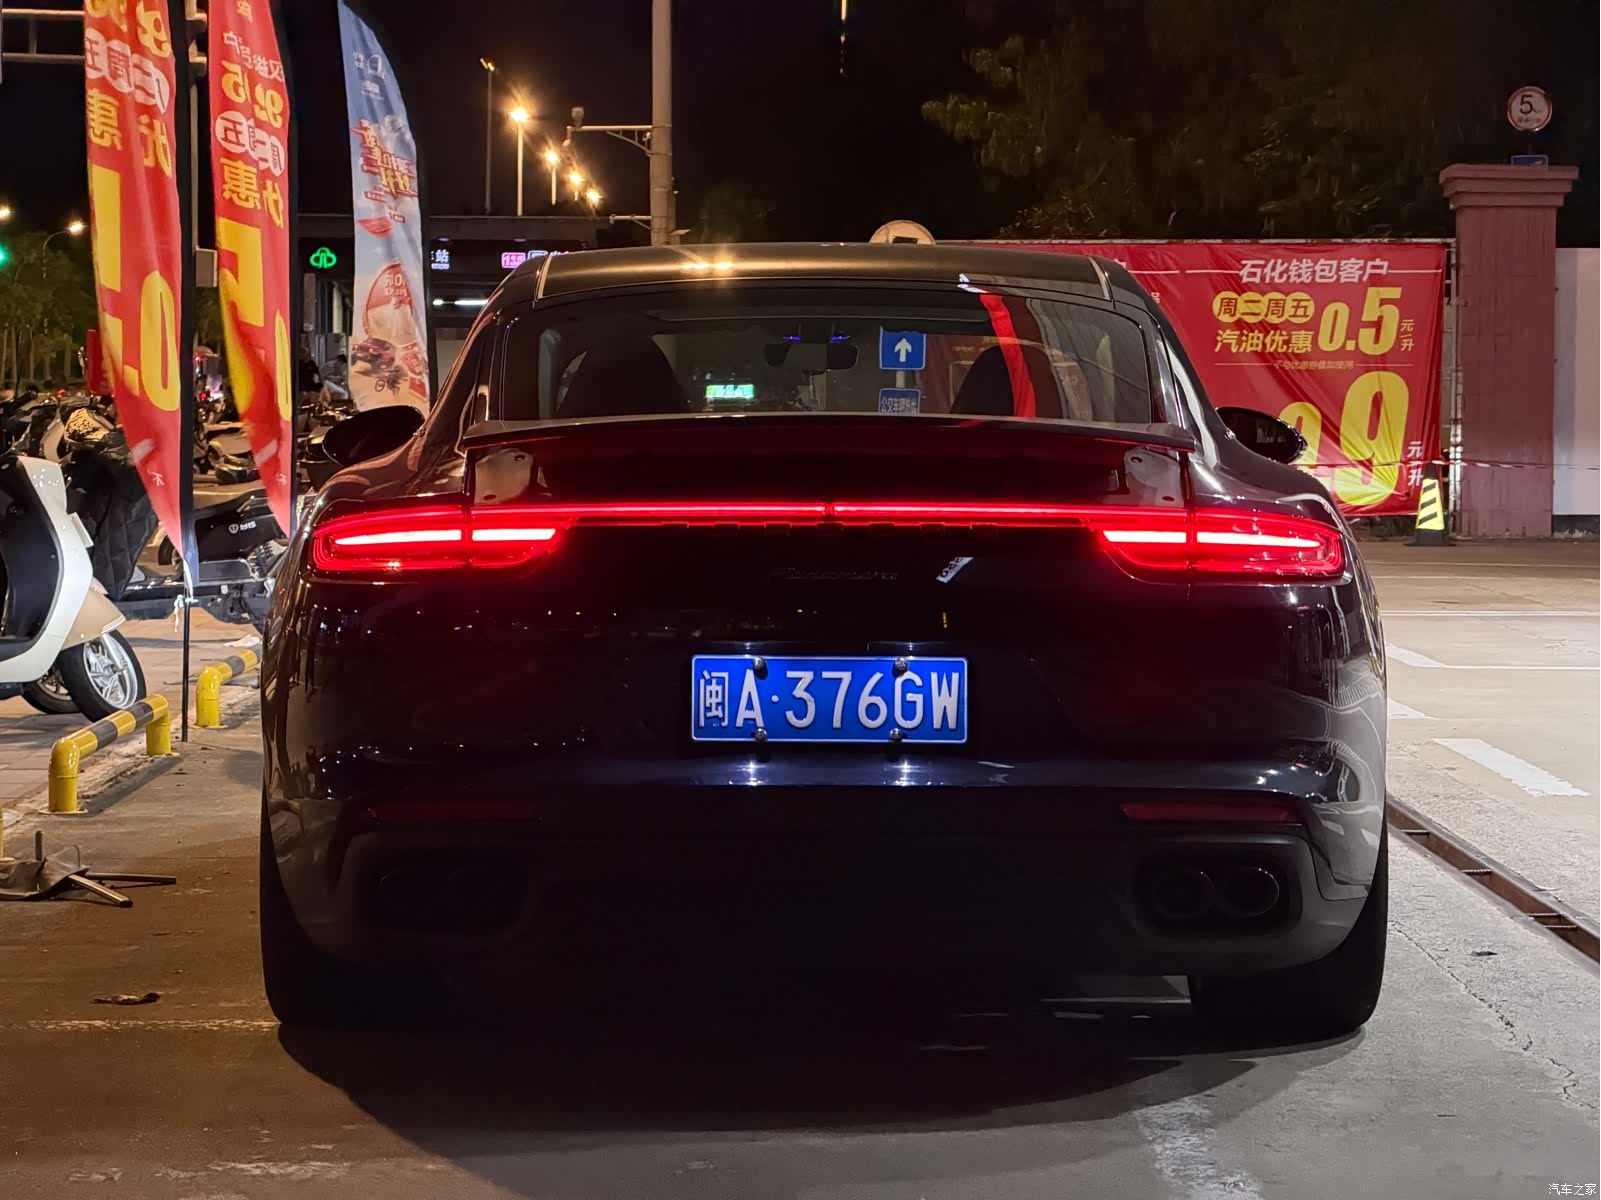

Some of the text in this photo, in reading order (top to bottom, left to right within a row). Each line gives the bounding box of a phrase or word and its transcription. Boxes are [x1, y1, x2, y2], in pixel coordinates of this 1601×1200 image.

[1239, 258, 1389, 283] 石化钱包客户
[1214, 294, 1314, 321] 周二周五
[1317, 286, 1403, 356] 0.5
[1214, 329, 1314, 353] 汽油优惠
[699, 666, 961, 730] 闽A·376GW
